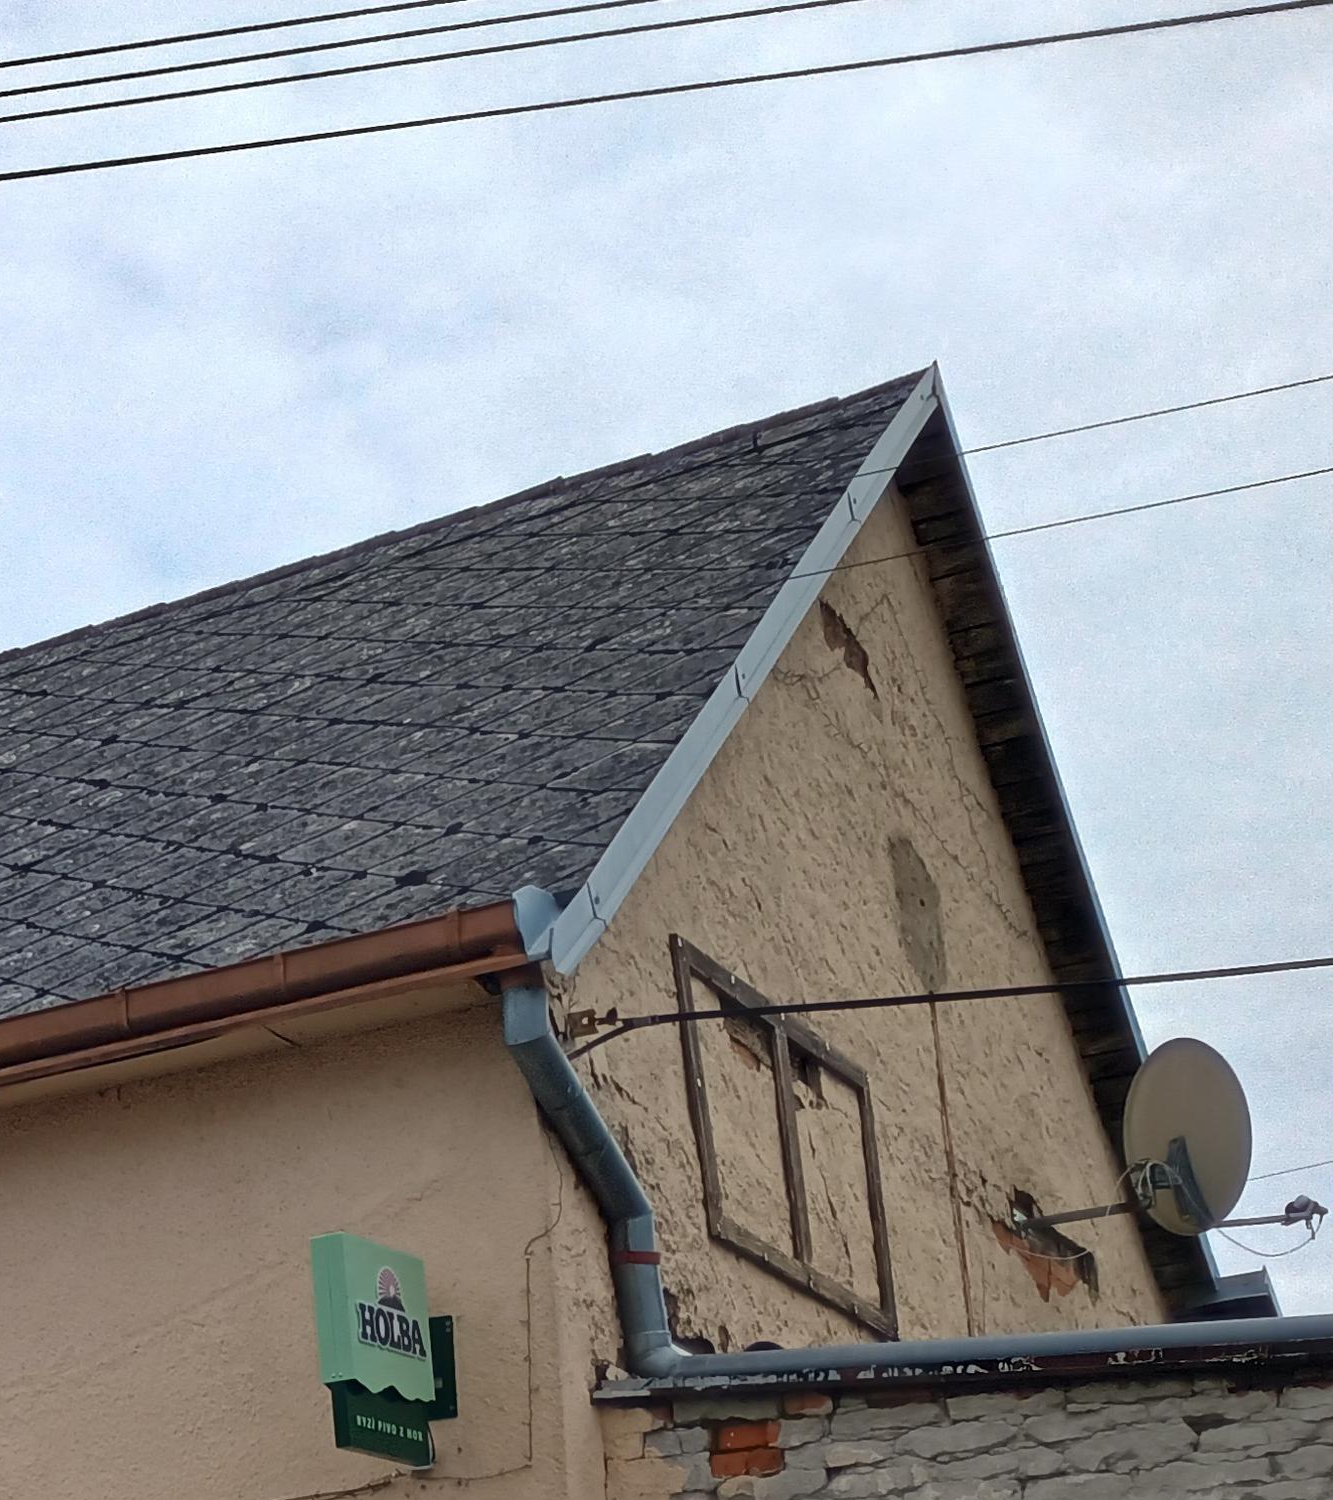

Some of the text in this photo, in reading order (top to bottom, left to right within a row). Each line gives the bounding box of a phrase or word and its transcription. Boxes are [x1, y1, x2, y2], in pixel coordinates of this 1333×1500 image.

[357, 1302, 428, 1358] HOLBA
[378, 1420, 397, 1436] PIVO
[399, 1426, 404, 1437] Z
